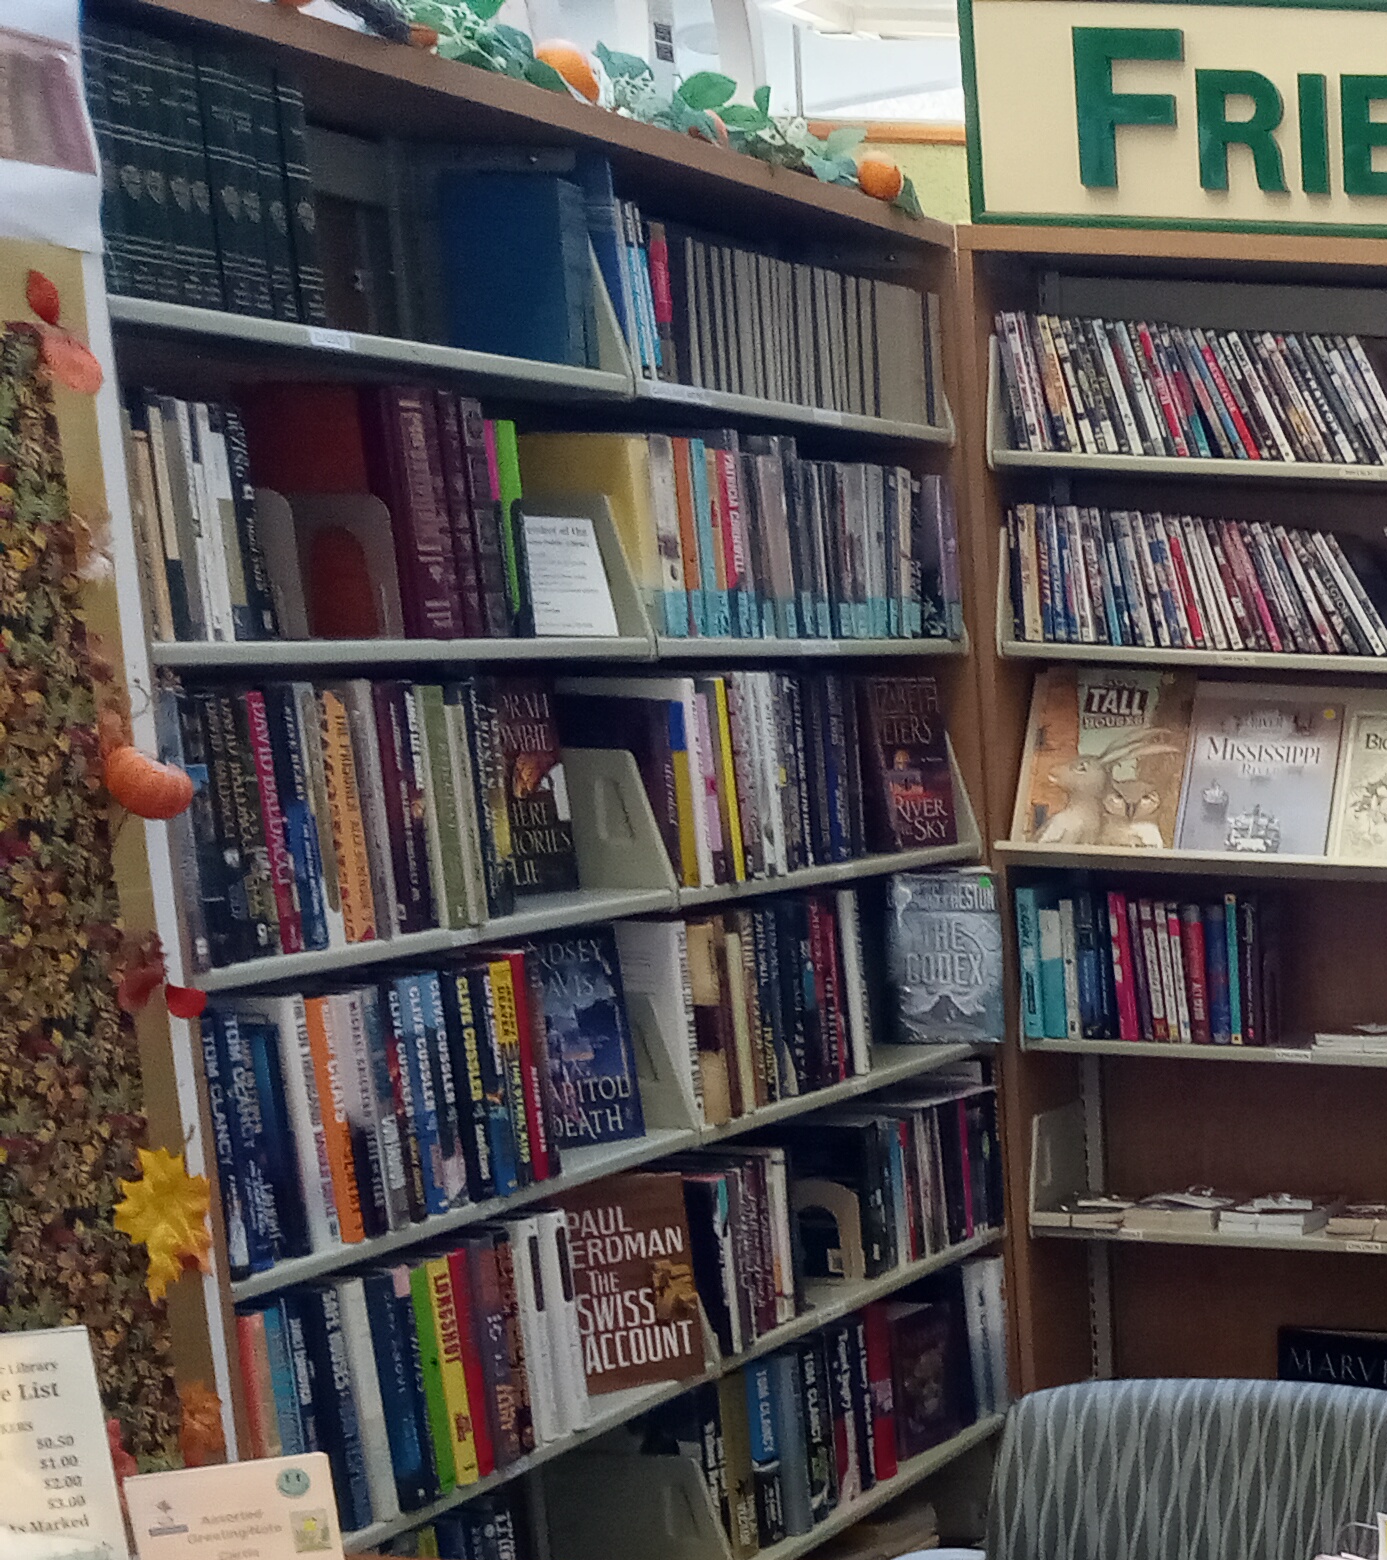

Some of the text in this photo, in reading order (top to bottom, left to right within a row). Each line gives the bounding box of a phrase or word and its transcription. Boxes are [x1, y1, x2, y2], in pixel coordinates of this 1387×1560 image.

[724, 452, 739, 512] PATRICIA
[1089, 687, 1146, 717] TALL
[1207, 735, 1321, 764] MISSISSIPPI
[904, 952, 987, 988] CODEX
[566, 1206, 633, 1238] PAUL
[568, 1226, 686, 1271] ERDMAN
[588, 1269, 620, 1295] THE
[576, 1289, 657, 1337] SWISS
[584, 1319, 694, 1376] ACCOUNT
[19, 1380, 61, 1399] List
[36, 1433, 75, 1450] $0.50
[40, 1454, 79, 1470] $1.00
[43, 1475, 83, 1491] $2.00
